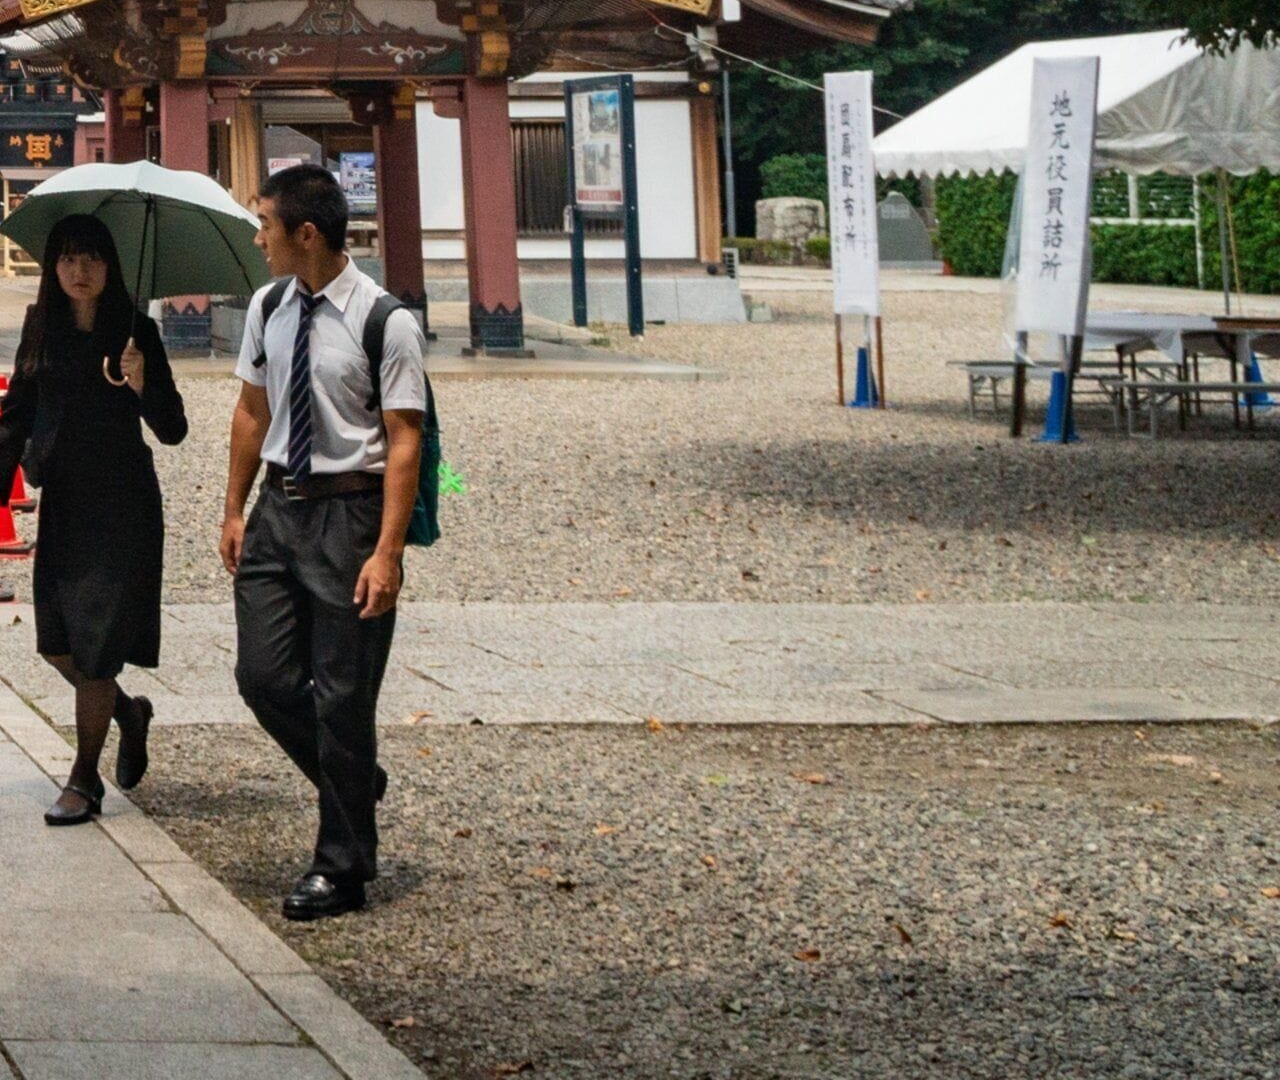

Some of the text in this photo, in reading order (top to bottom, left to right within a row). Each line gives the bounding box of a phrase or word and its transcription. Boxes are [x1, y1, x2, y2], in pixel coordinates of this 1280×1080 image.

[1040, 89, 1073, 281] 地元役員詰所
